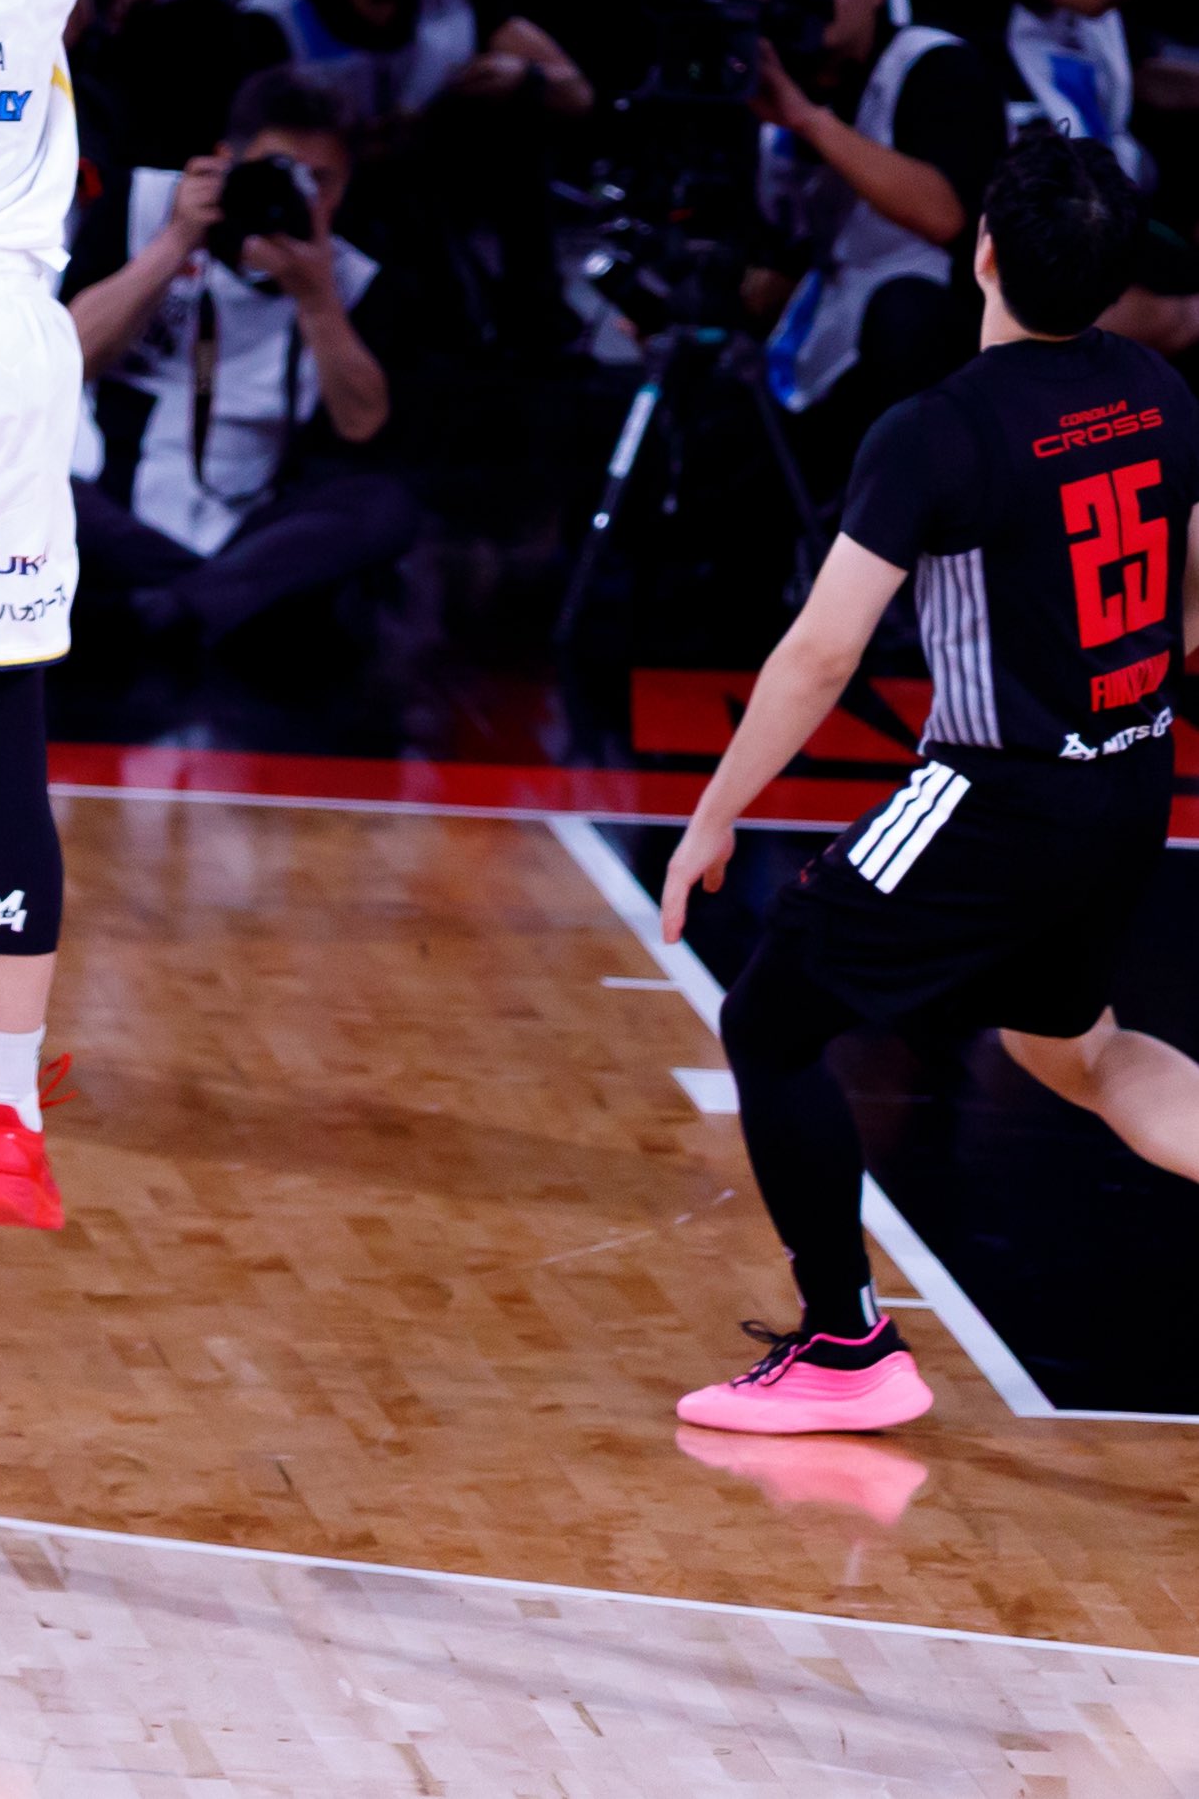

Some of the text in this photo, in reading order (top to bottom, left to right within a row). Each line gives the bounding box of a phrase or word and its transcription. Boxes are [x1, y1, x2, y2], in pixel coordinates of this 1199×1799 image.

[1032, 407, 1164, 459] CROSS
[1059, 399, 1128, 428] COROLLA
[1059, 458, 1170, 650] 25
